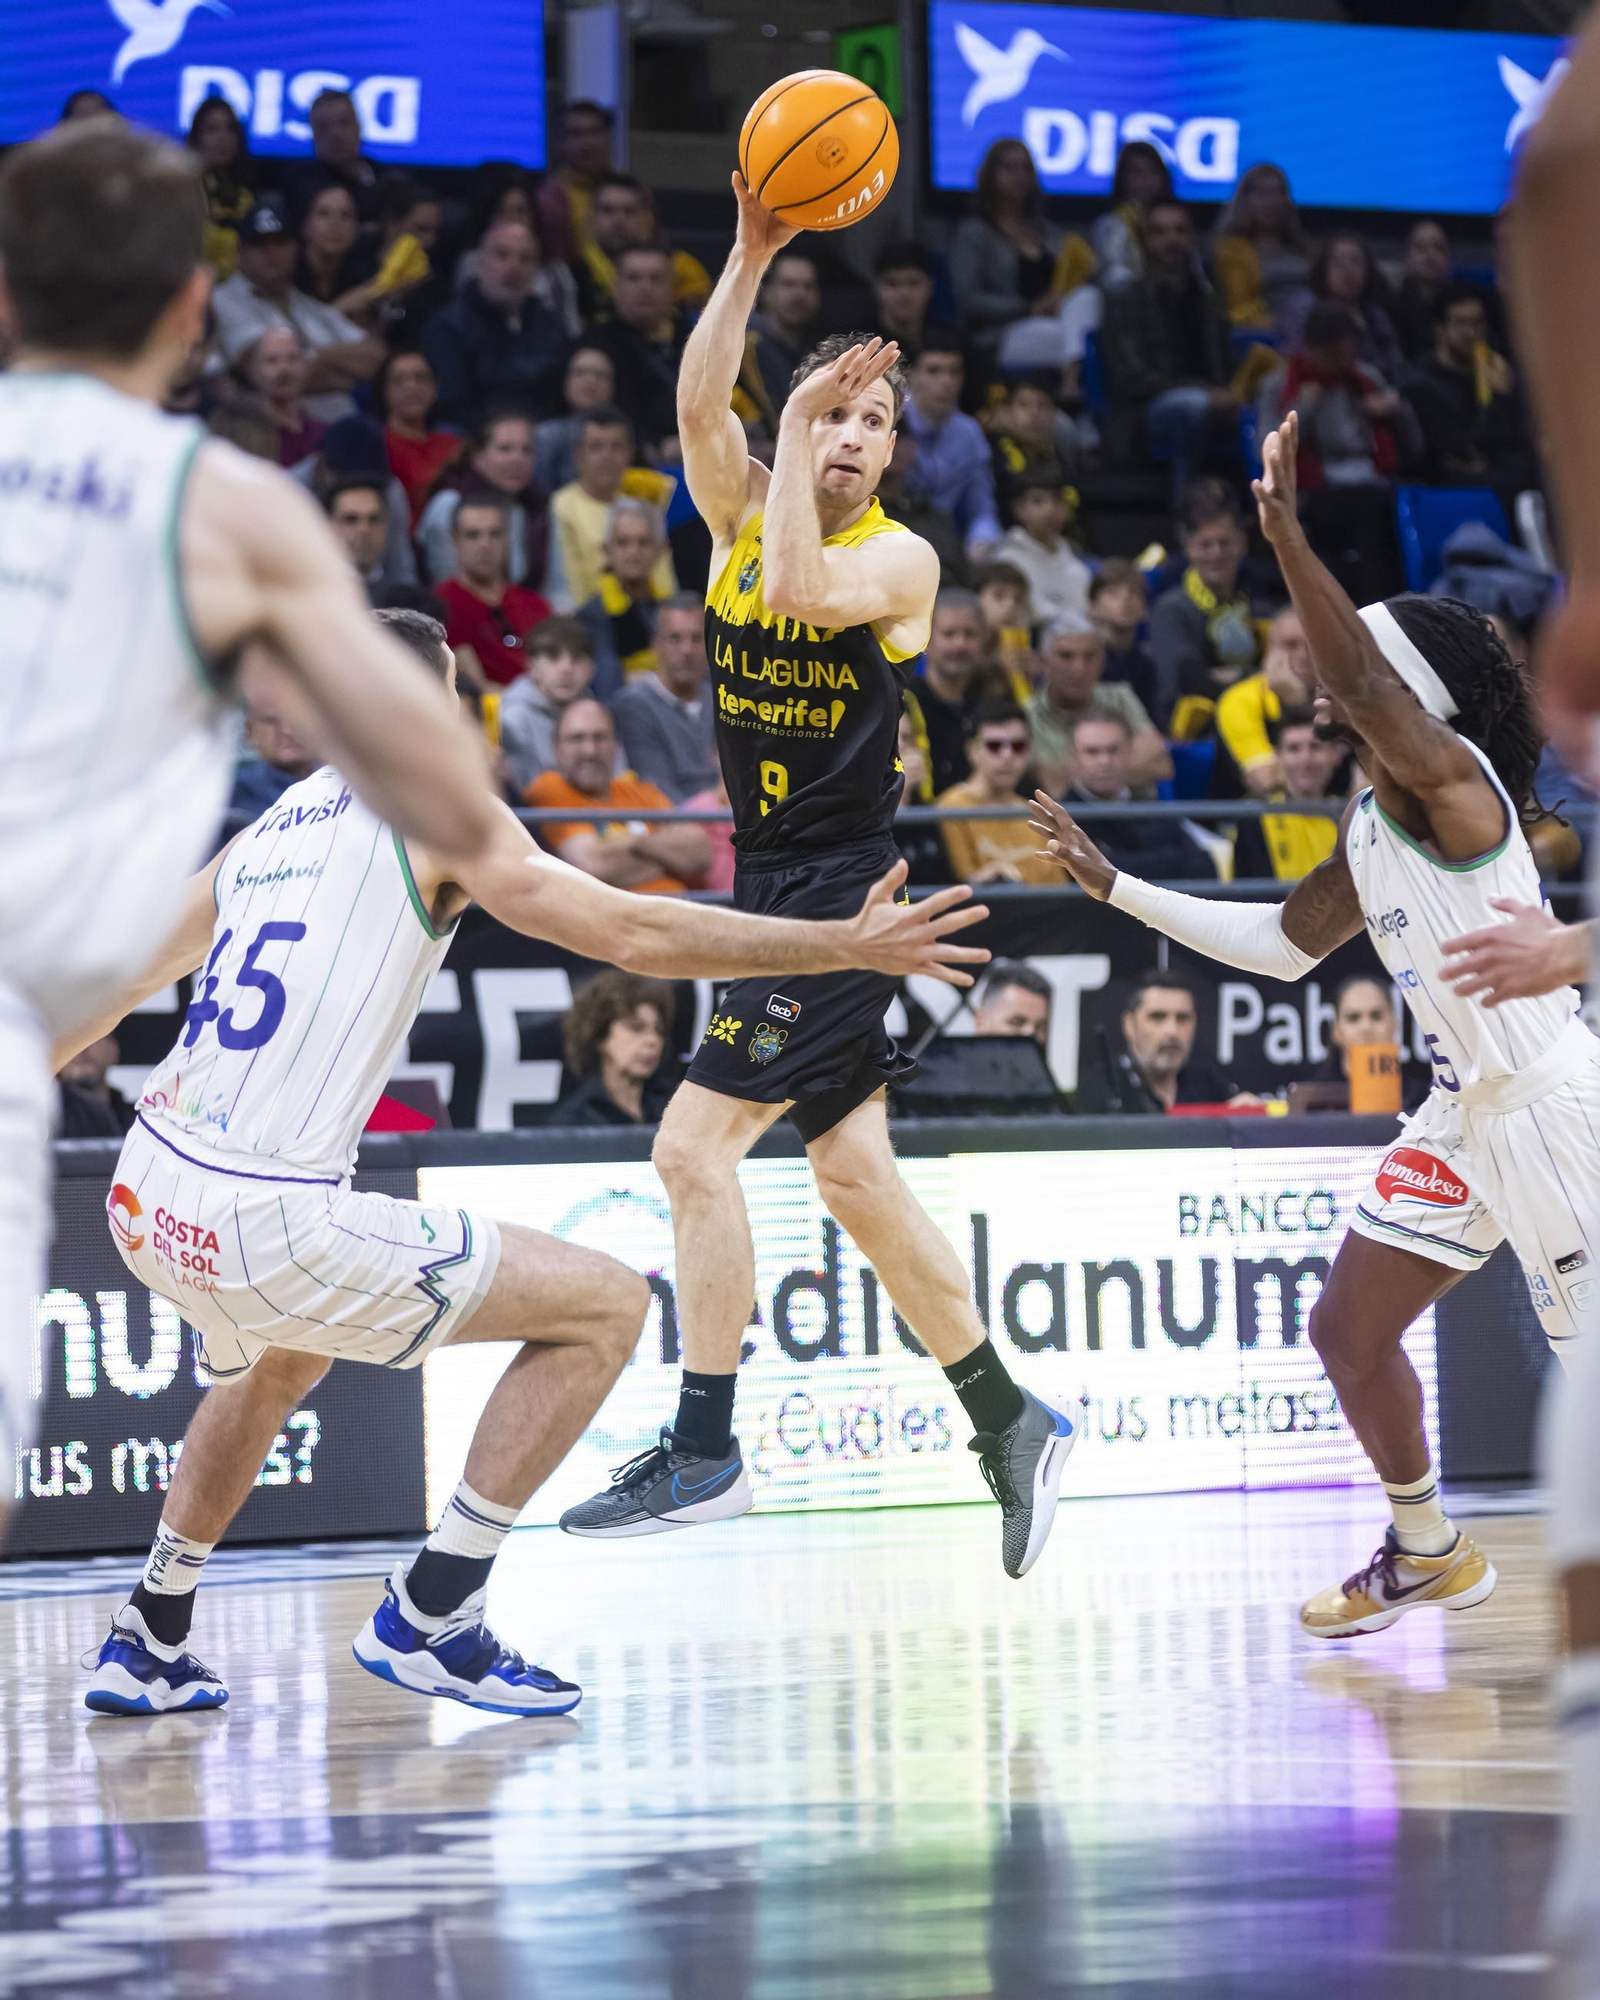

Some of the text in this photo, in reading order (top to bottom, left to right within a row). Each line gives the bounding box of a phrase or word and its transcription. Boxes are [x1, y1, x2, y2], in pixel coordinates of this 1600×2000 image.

[715, 635, 859, 690] LA LAGUNA
[719, 711, 826, 739] despierta emociones
[760, 760, 788, 817] 9
[184, 921, 307, 1049] 45
[770, 1004, 792, 1018] acb
[1381, 1149, 1465, 1200] famadesa
[155, 1207, 220, 1254] COSTA
[1178, 1190, 1337, 1237] BANCO
[153, 1231, 220, 1276] DEL SOL
[1559, 1259, 1583, 1273] acb
[1078, 1385, 1150, 1442] tus
[147, 1541, 178, 1587] UNICAJA
